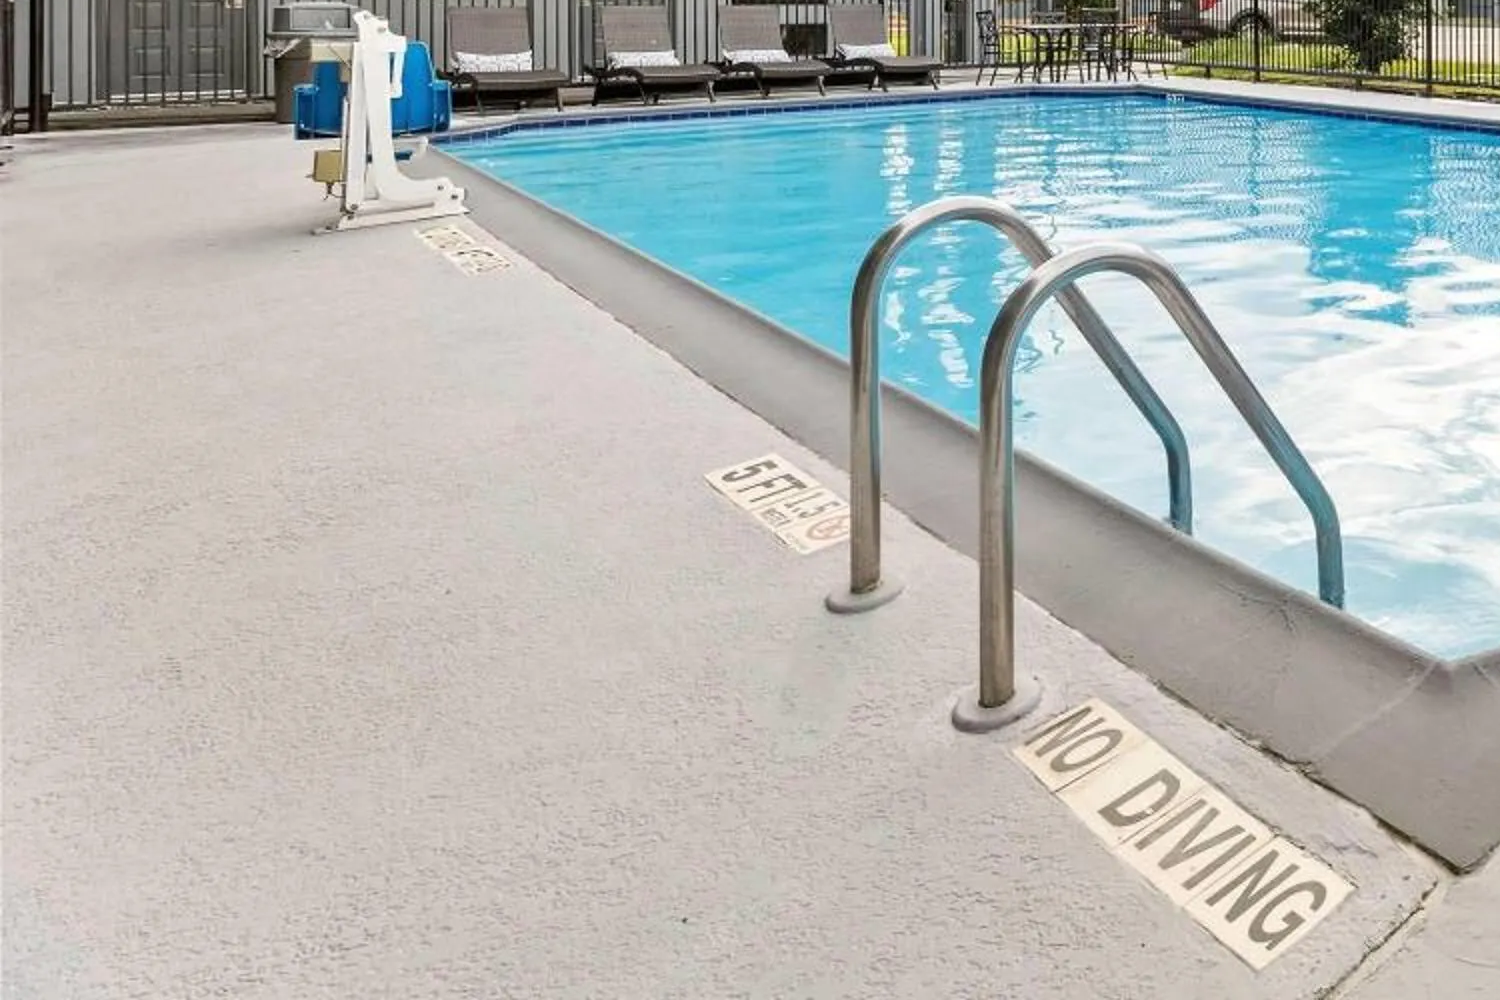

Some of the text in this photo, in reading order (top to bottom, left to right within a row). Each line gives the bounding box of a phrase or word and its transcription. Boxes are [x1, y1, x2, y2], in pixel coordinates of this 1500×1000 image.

[721, 459, 808, 503] 5 FT
[1024, 706, 1328, 951] NO DIVING
